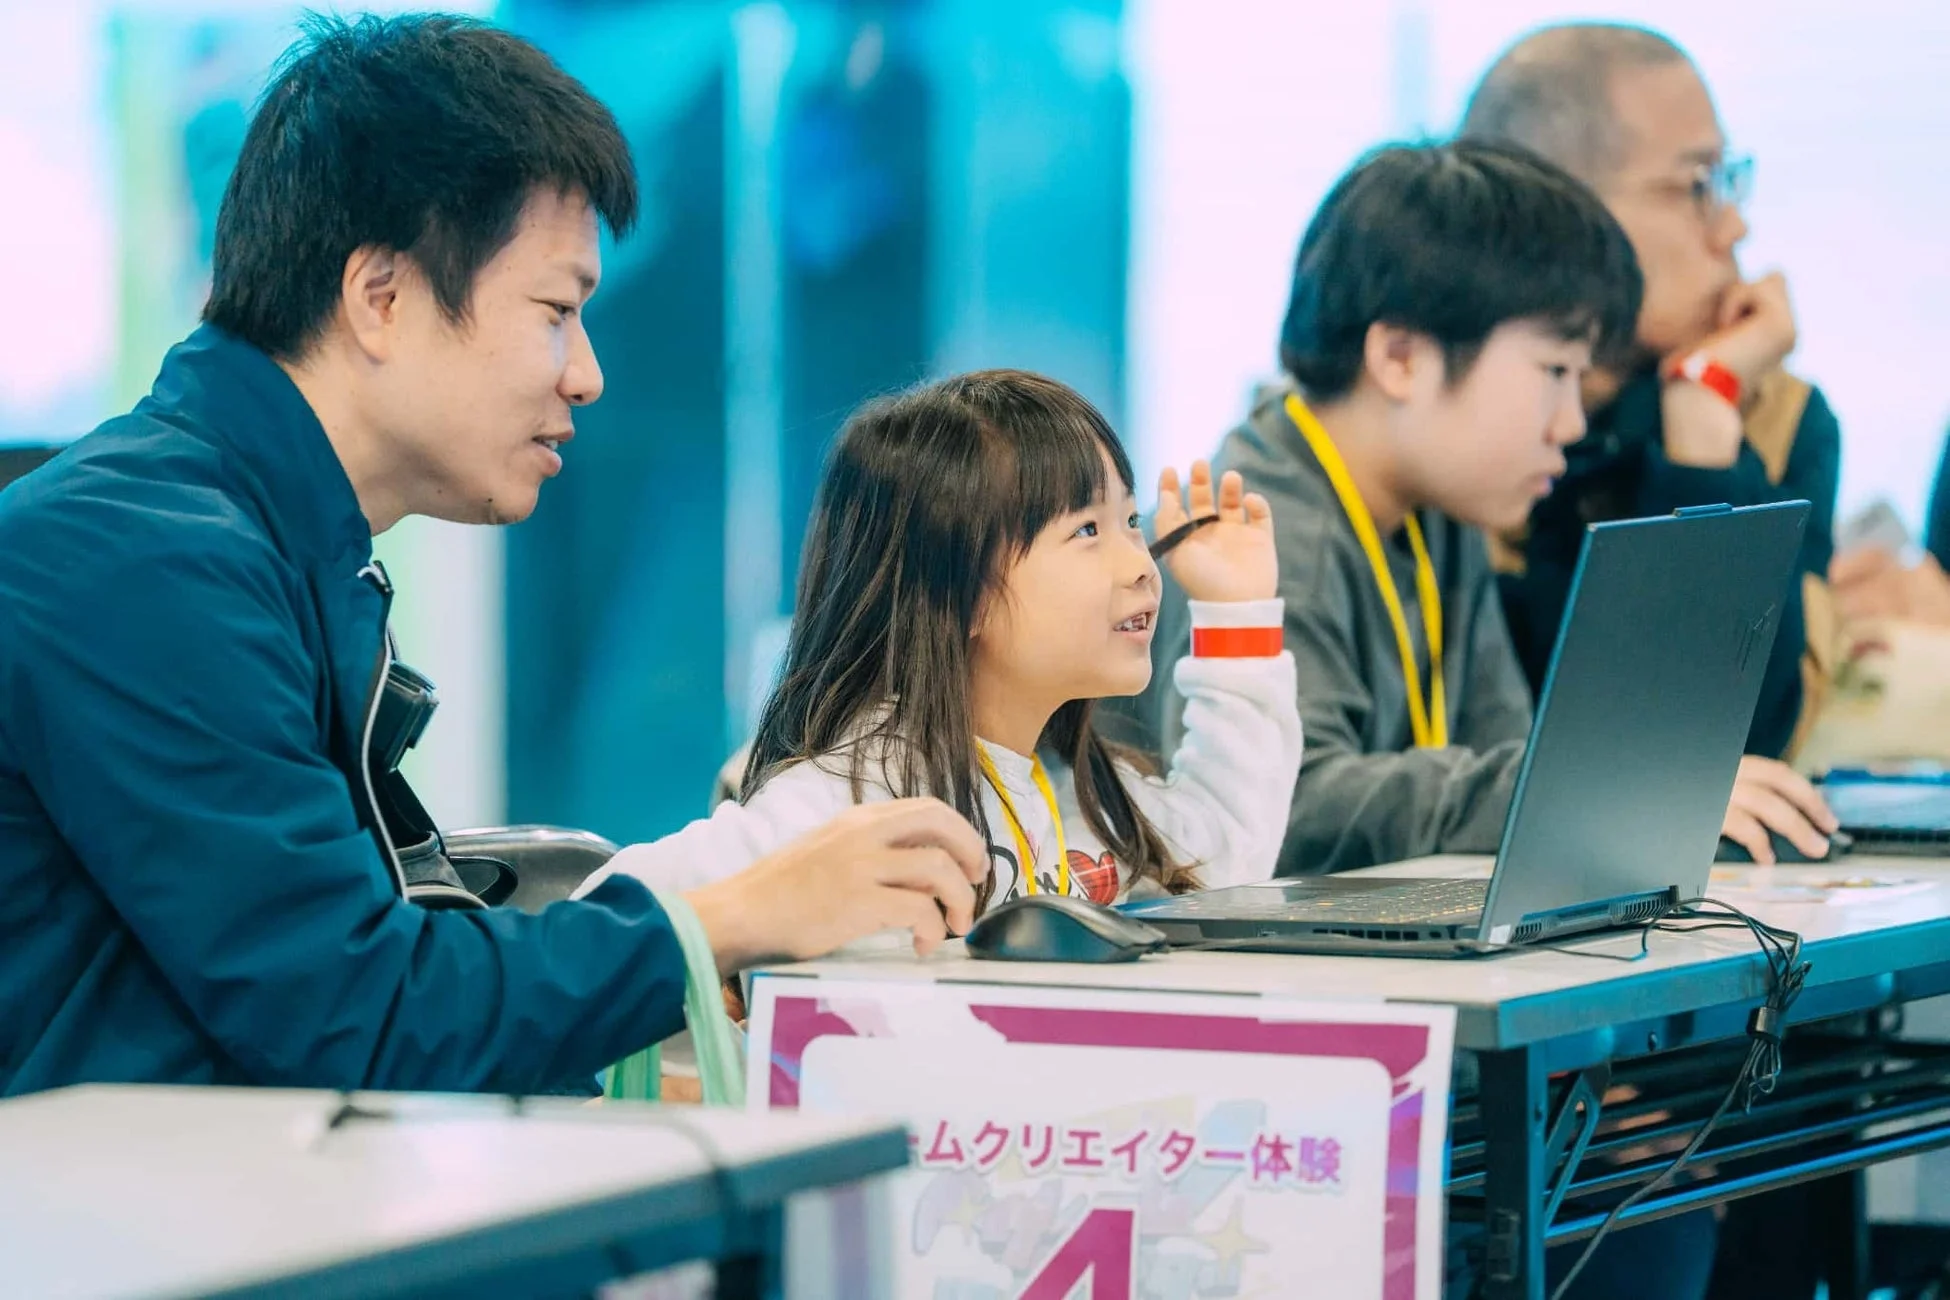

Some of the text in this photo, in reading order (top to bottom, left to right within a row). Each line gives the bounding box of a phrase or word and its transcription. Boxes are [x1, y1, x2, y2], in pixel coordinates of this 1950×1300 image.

[908, 1120, 1342, 1183] ムクリエイター体験
